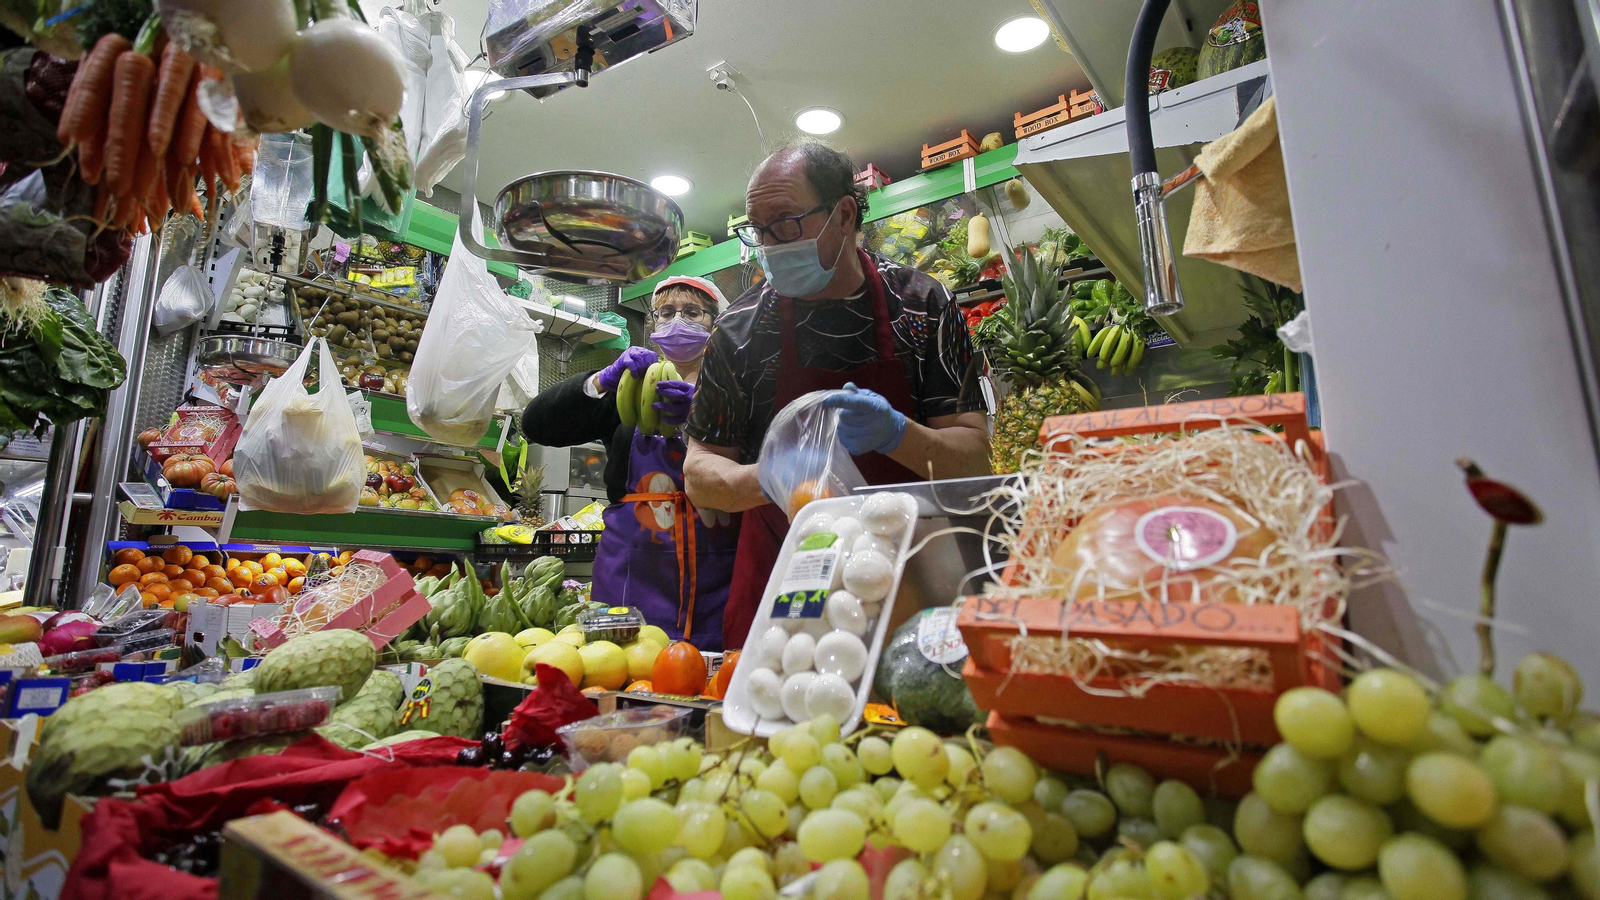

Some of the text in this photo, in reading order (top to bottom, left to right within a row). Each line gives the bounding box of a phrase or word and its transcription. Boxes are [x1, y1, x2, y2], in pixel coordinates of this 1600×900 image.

[1079, 103, 1095, 113] WOO
[1022, 115, 1059, 134] WOOD BOX
[929, 148, 962, 164] WOOD BOX
[1130, 405, 1163, 427] AL
[1172, 394, 1296, 416] SABOR
